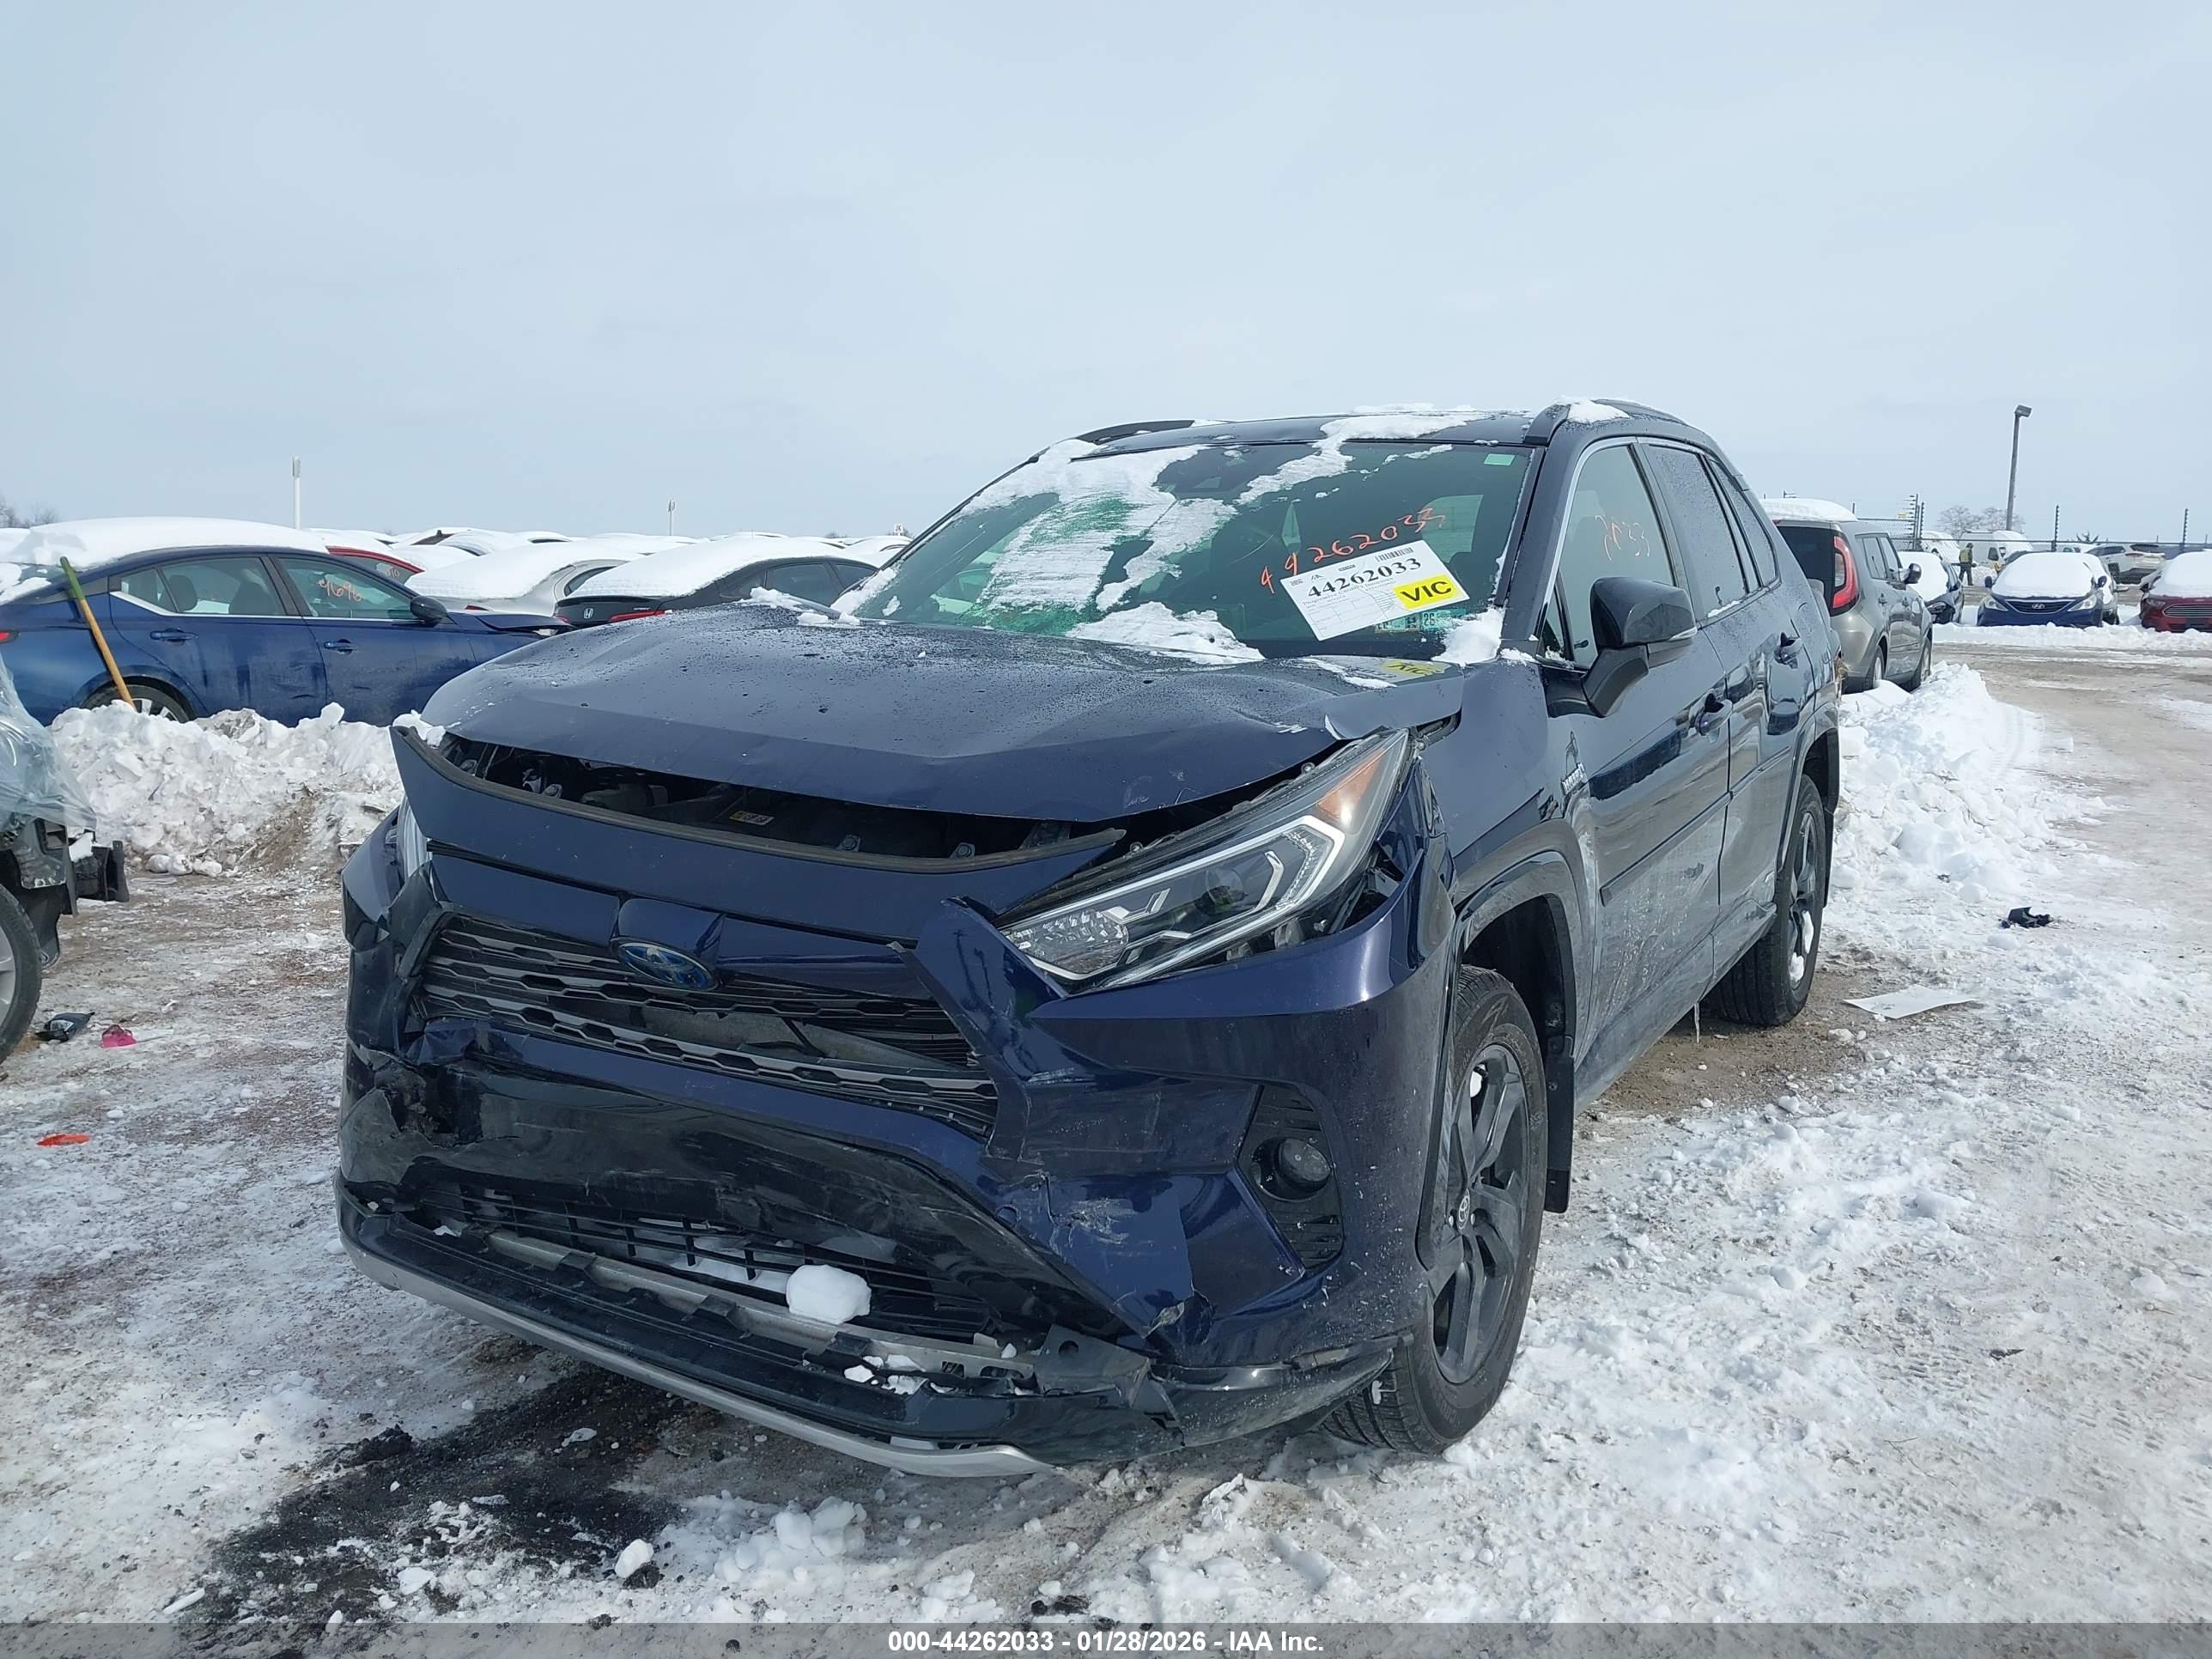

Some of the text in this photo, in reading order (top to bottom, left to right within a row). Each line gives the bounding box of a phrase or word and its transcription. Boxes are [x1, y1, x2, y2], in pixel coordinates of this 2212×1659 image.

[1308, 557, 1421, 598] 44262033
[1400, 580, 1452, 602] VIC
[1423, 612, 1435, 626] 26
